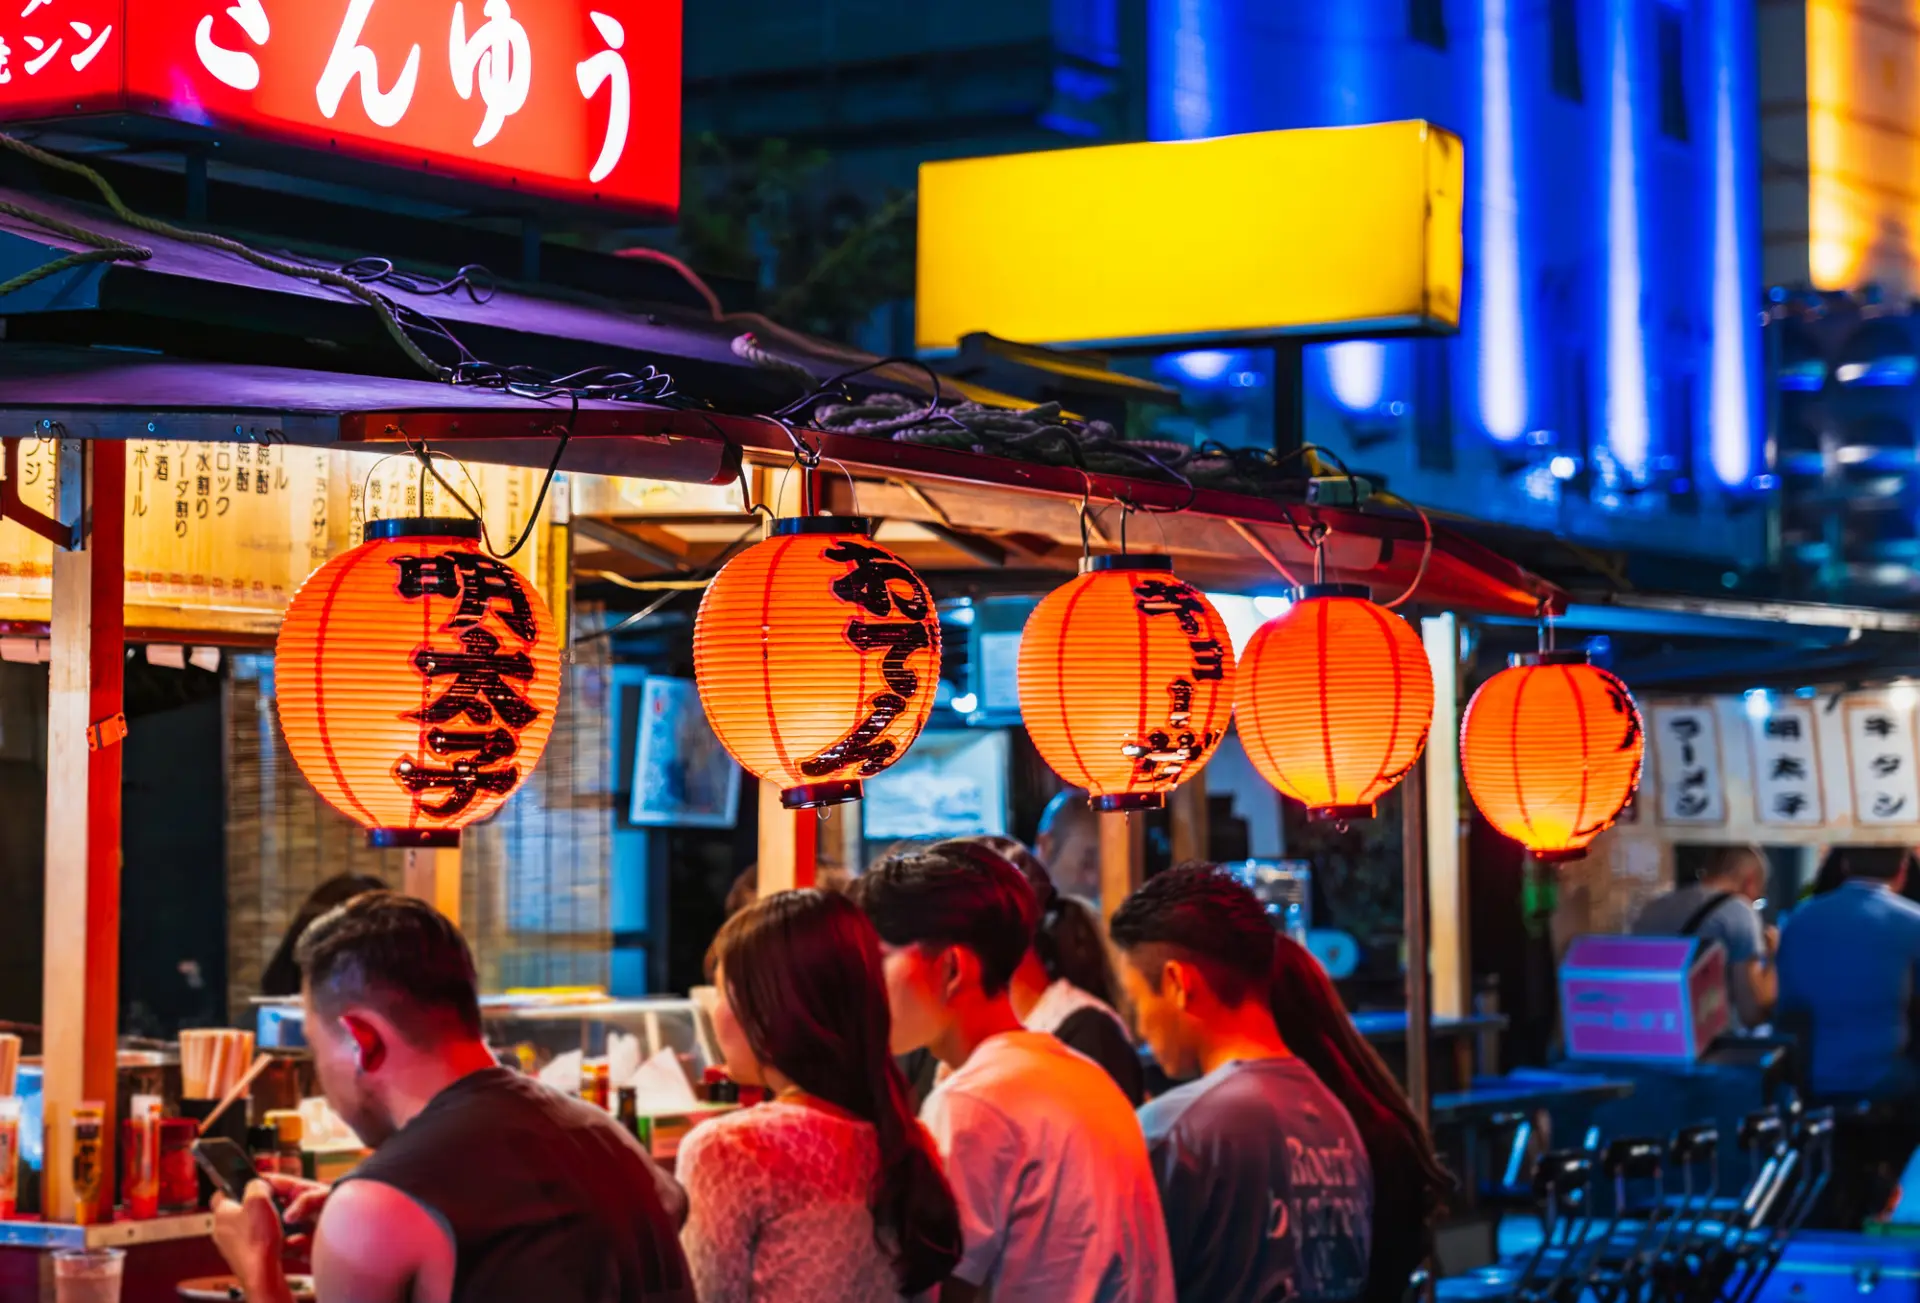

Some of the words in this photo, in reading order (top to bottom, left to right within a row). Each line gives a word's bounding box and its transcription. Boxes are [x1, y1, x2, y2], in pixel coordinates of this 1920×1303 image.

[195, 0, 631, 183] さんゆう
[394, 551, 541, 817] 明太子
[799, 540, 938, 778] おでん
